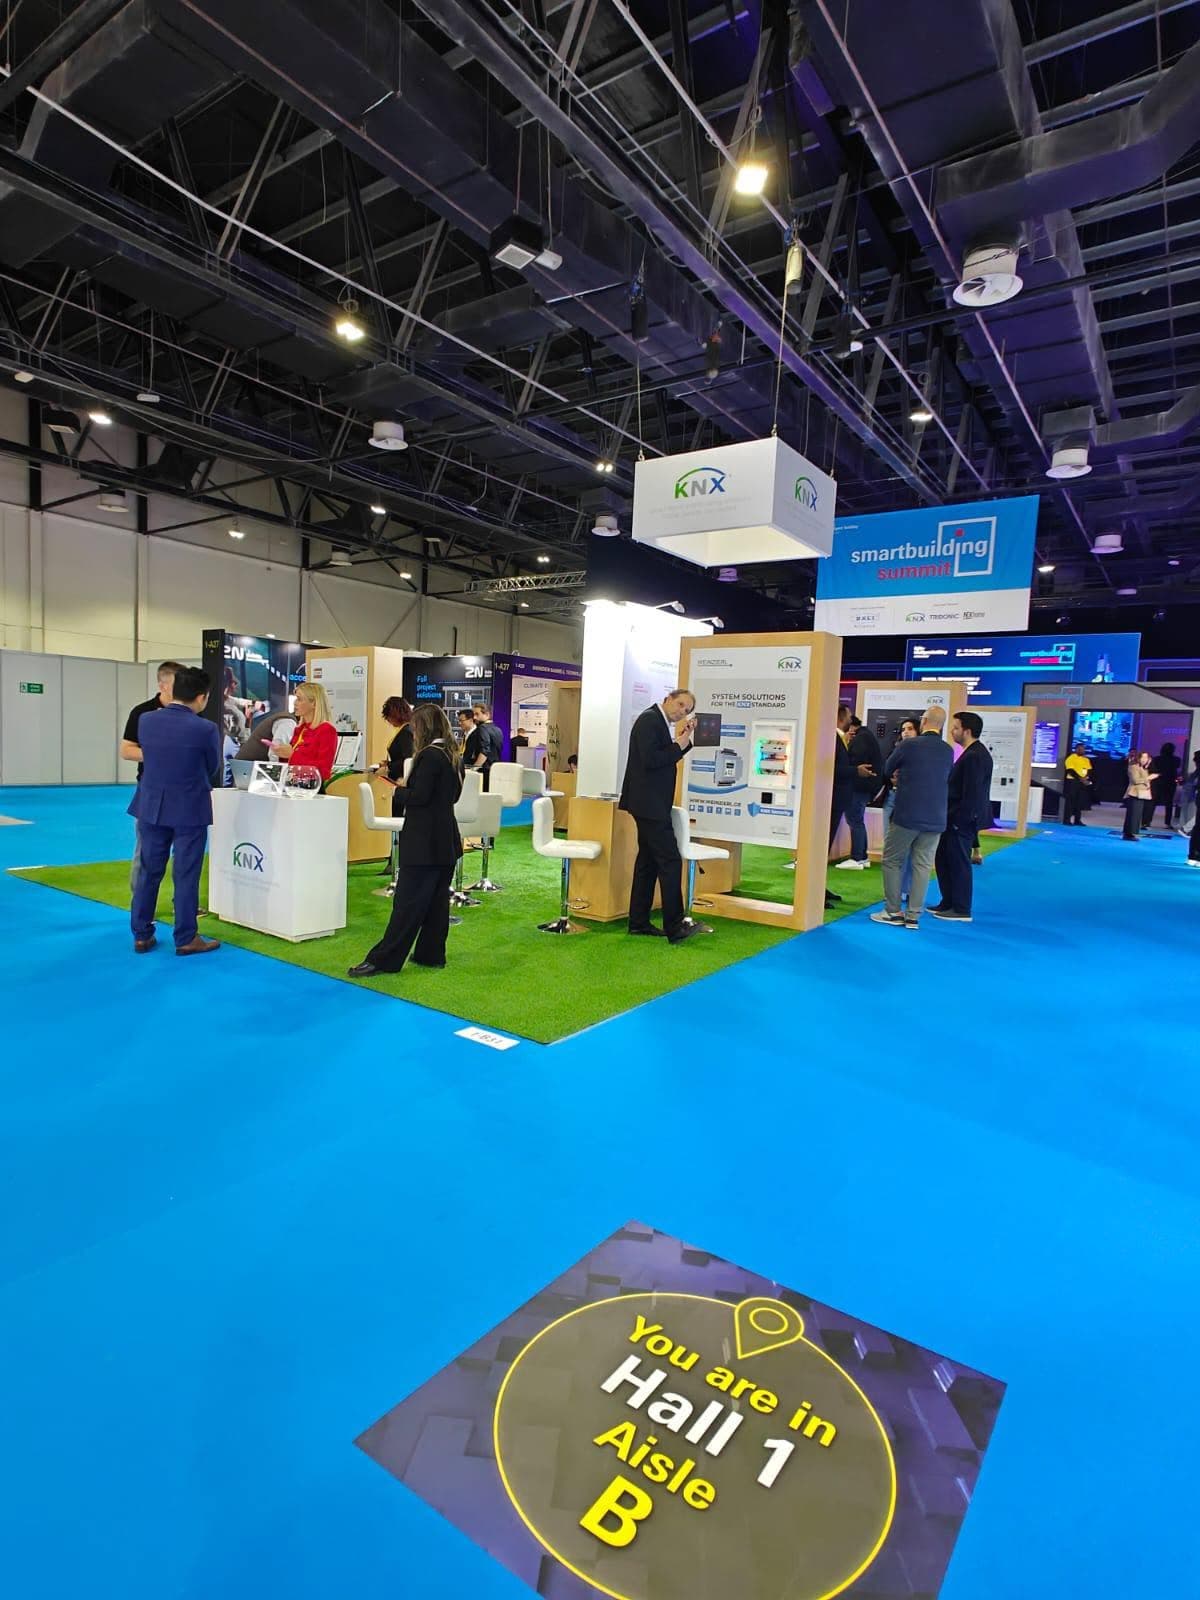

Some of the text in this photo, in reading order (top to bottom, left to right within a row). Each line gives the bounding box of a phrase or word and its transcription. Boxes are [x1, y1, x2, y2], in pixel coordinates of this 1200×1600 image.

[673, 475, 726, 499] KNX
[795, 483, 818, 511] KNX
[850, 528, 988, 563] smartbuilding
[877, 560, 951, 581] summit
[905, 614, 926, 622] KNX
[464, 665, 484, 679] 2N
[777, 660, 802, 669] KNX
[416, 684, 437, 692] project
[711, 693, 787, 701] SYSTEM SOLUTIONS
[233, 850, 264, 873] KNX
[629, 1315, 837, 1447] You are in
[600, 1354, 795, 1488] Hall 1
[593, 1421, 716, 1510] Aisle
[579, 1475, 653, 1548] B
